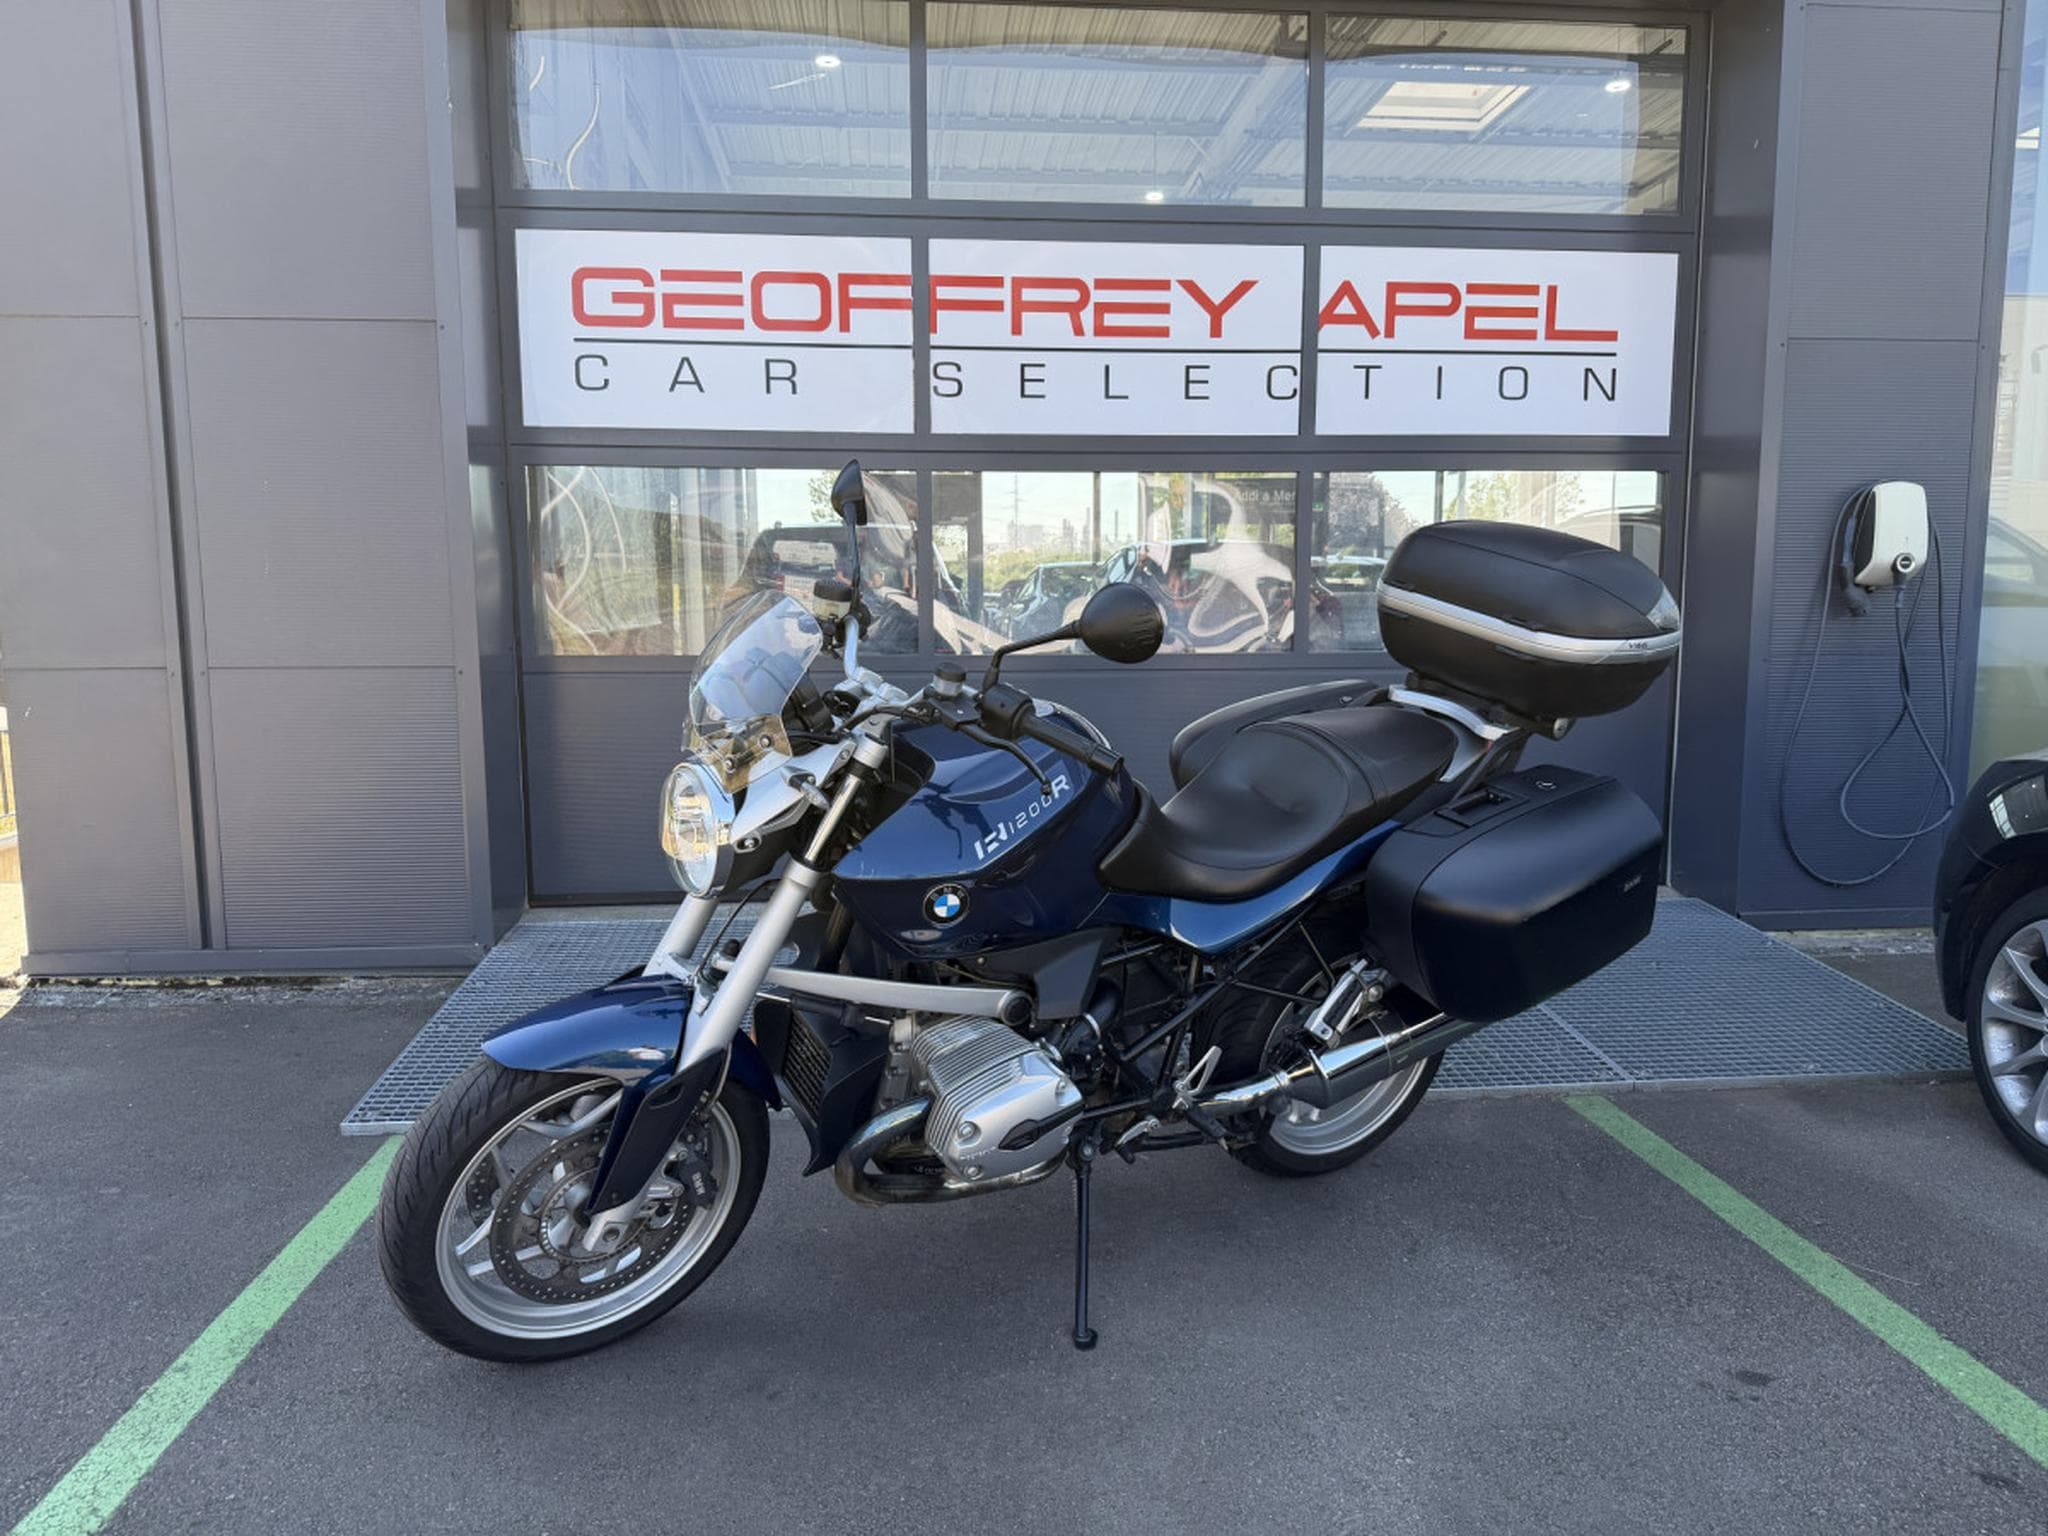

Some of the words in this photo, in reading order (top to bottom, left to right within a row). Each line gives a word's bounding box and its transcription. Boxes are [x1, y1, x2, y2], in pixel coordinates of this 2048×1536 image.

[571, 266, 1259, 339] GEOFFREY
[1317, 279, 1619, 342] APEL
[574, 354, 798, 395] CAR
[931, 361, 1617, 402] SELECTION
